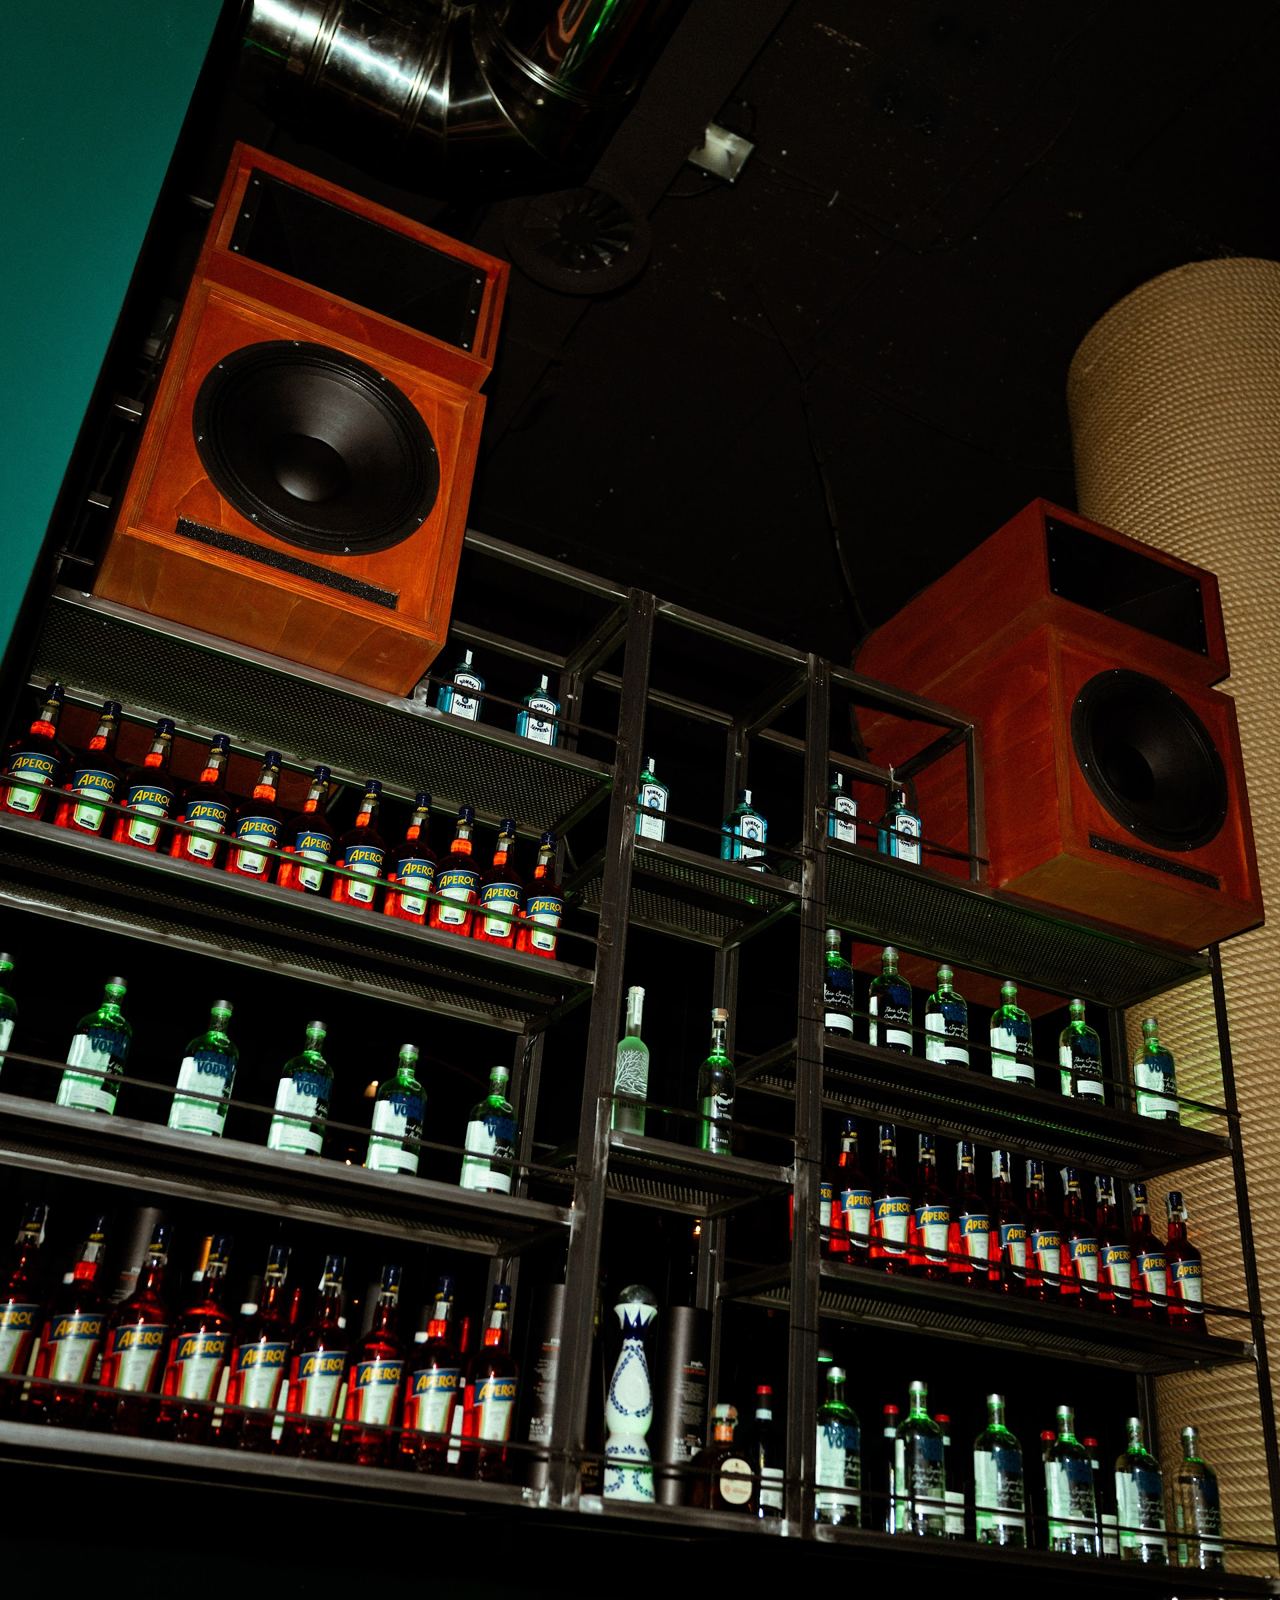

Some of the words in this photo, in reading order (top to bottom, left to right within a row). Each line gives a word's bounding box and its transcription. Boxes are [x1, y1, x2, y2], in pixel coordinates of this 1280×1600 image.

[12, 756, 54, 774] APEROL
[78, 773, 116, 793] APEROL
[132, 789, 170, 808] APEROL
[191, 805, 227, 822] APEROL
[240, 820, 278, 836] APEROL
[300, 835, 332, 852] APERO
[439, 875, 475, 890] APEROL
[485, 887, 519, 901] APEROL
